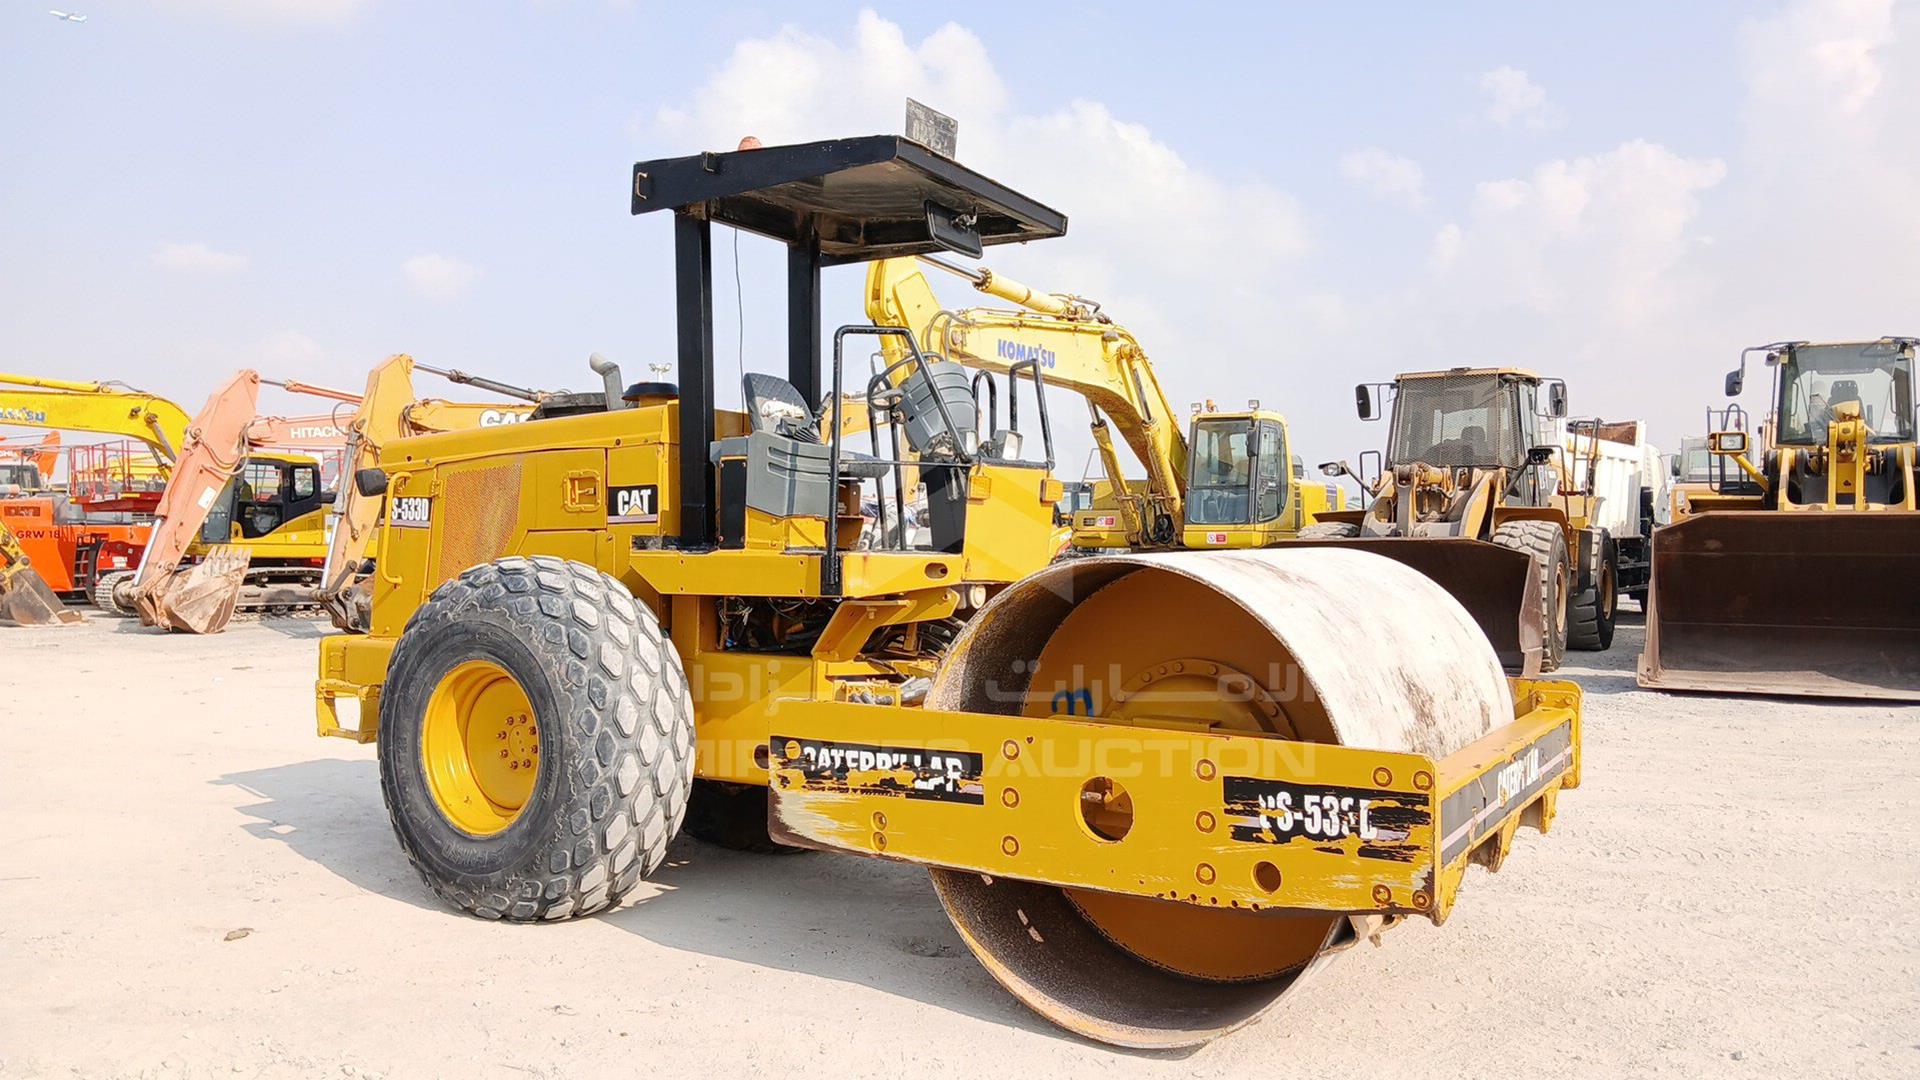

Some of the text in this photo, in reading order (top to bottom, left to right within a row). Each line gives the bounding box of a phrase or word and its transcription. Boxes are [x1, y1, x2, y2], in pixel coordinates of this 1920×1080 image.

[997, 339, 1056, 369] KOMATSU
[617, 488, 652, 516] CAT
[16, 530, 45, 539] GRW
